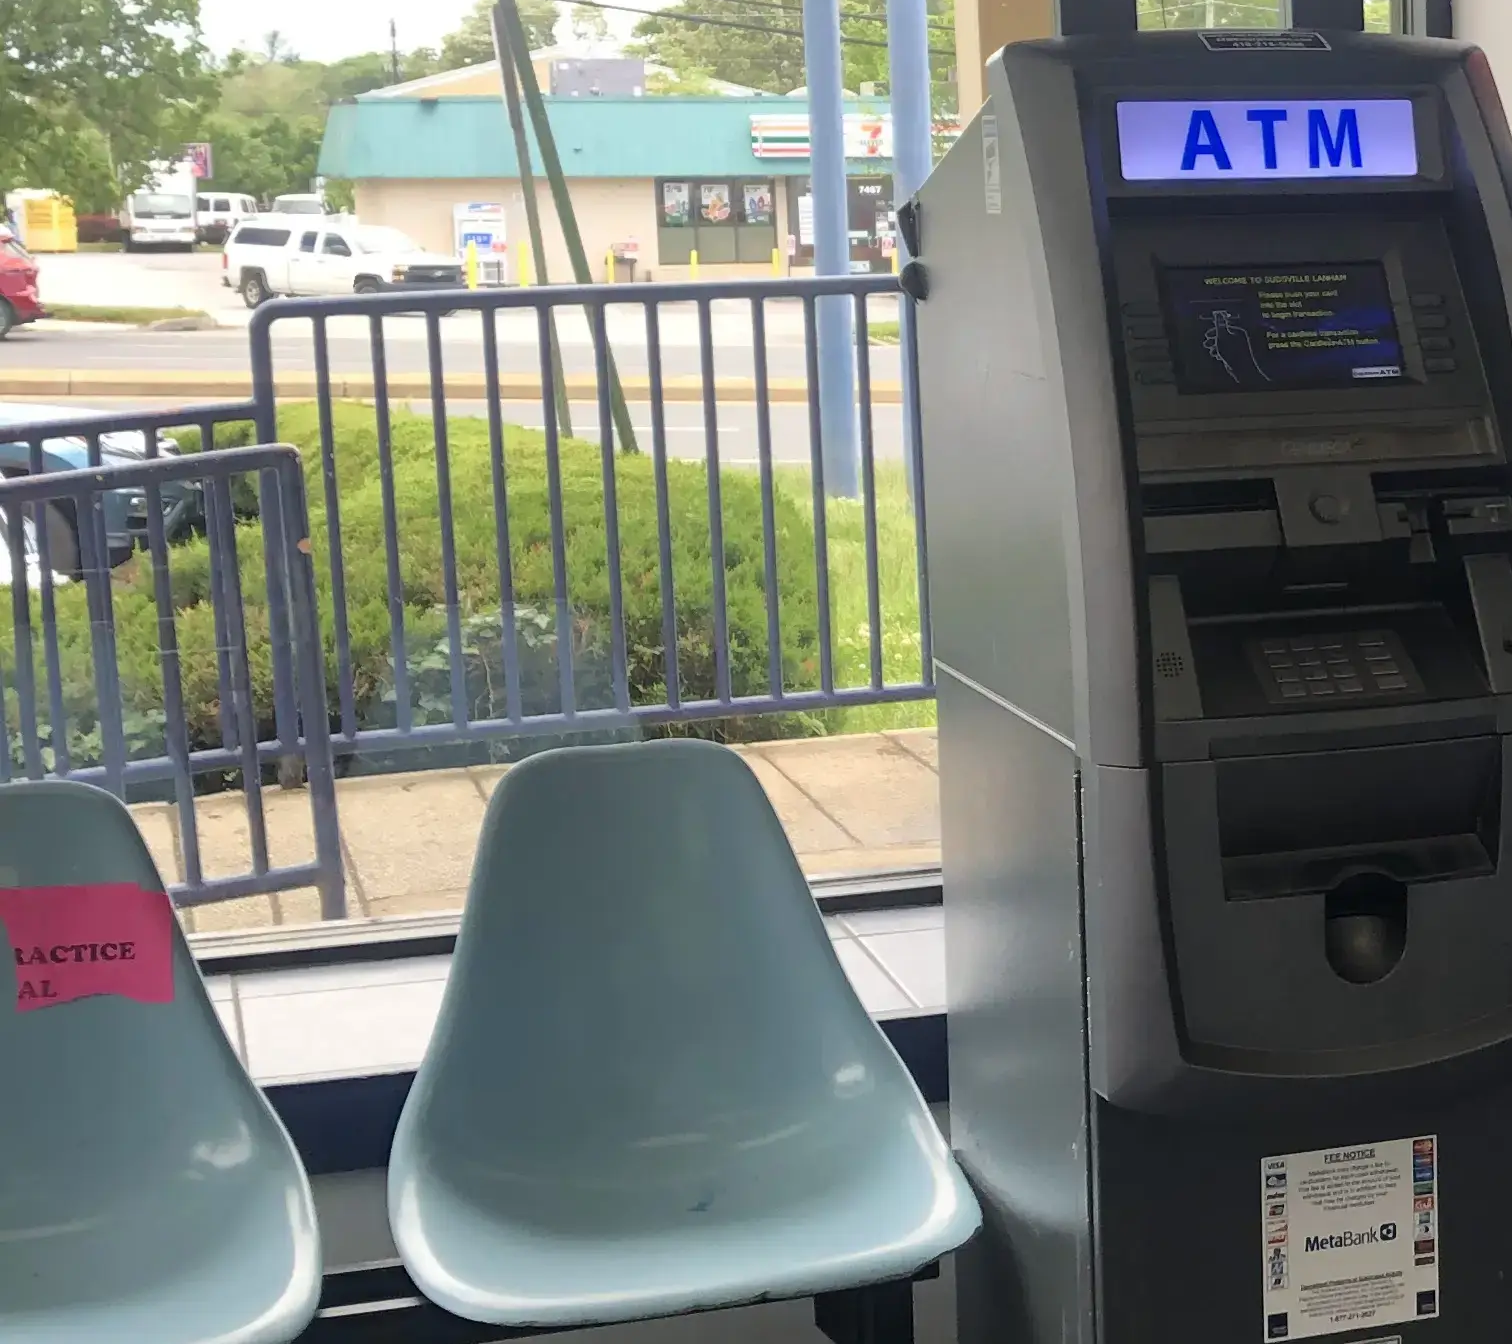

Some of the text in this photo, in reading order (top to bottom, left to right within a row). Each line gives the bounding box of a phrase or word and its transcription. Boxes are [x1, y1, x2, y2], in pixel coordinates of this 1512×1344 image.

[1180, 107, 1364, 171] ATM
[1343, 1148, 1376, 1162] NOTICE
[1304, 1226, 1379, 1253] MetaBank
